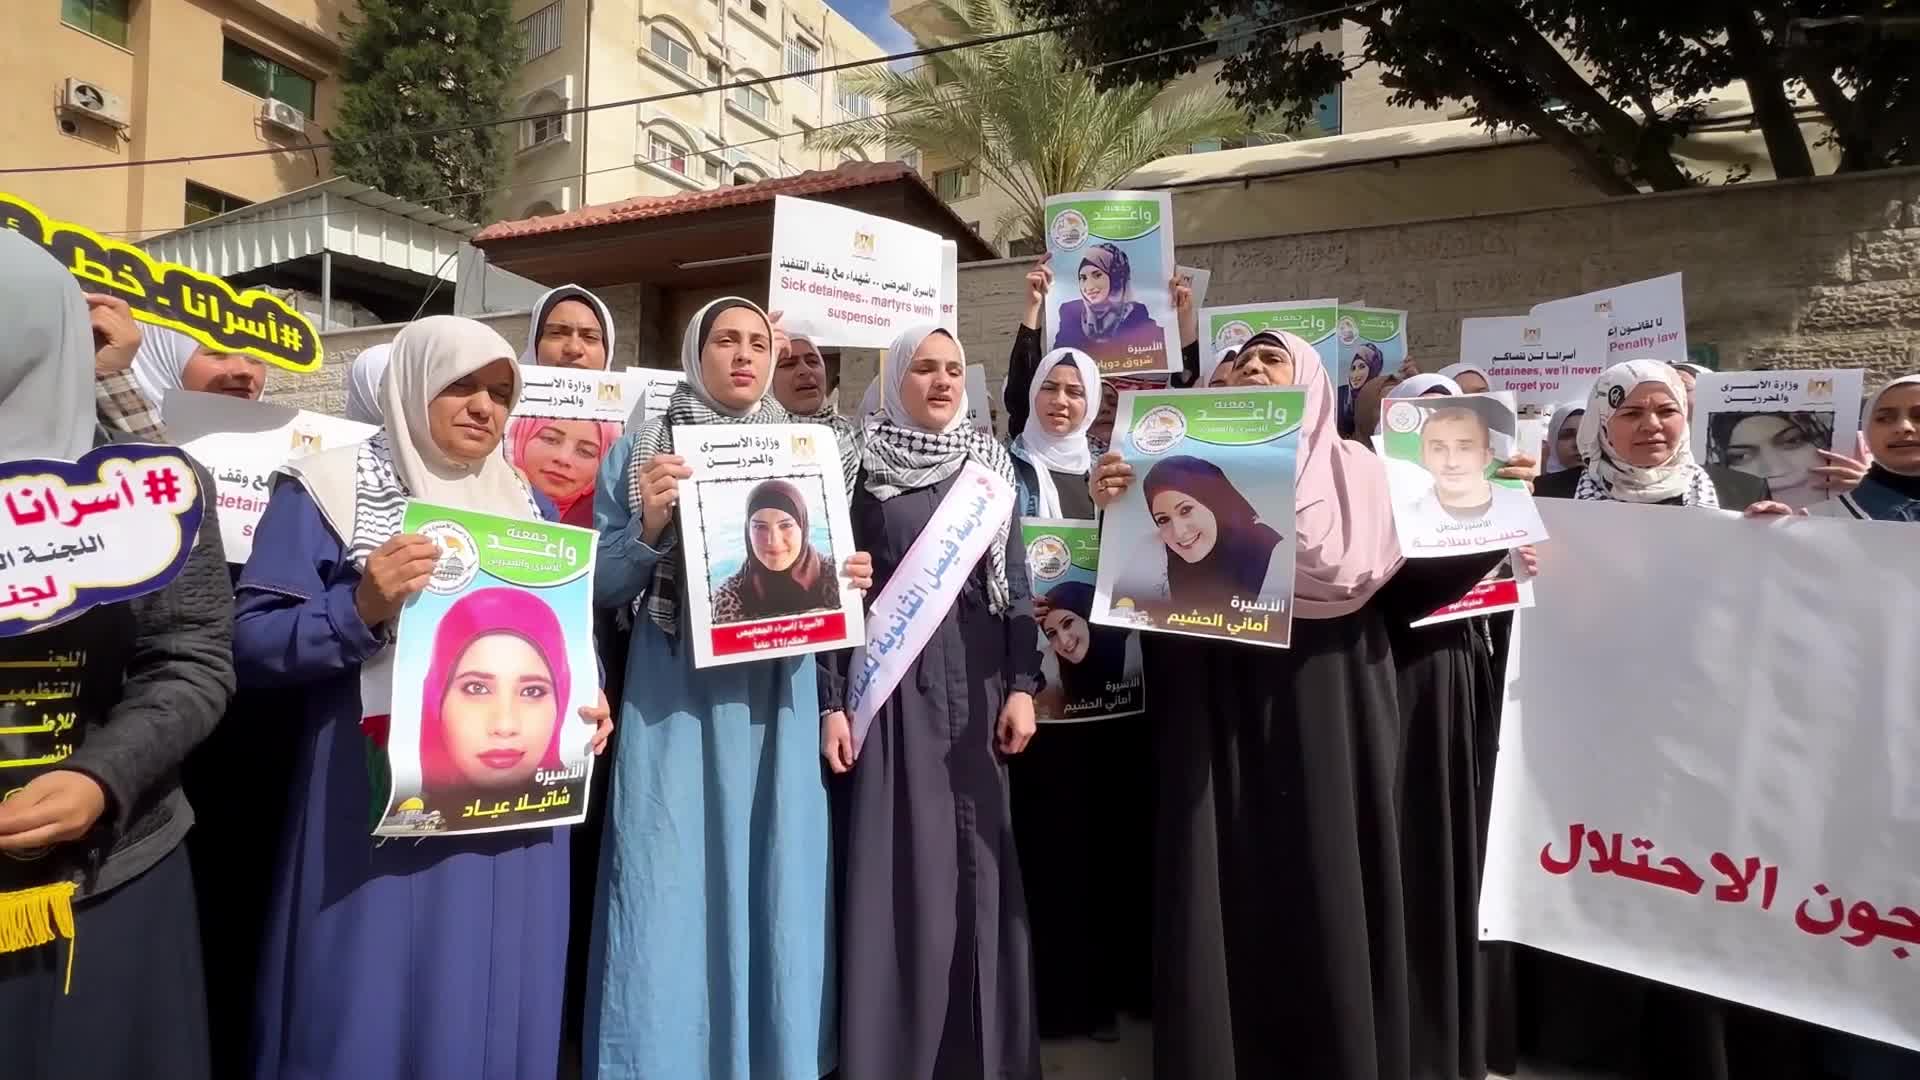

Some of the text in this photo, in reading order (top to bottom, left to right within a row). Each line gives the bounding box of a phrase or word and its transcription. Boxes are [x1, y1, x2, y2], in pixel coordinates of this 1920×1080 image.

[1093, 206, 1152, 224] واعد
[69, 246, 147, 297] خط
[779, 256, 809, 272] التنفيذ
[811, 261, 830, 279] وقف
[831, 268, 844, 281] مع
[846, 270, 871, 286] شهداء
[781, 277, 806, 291] Sick
[871, 295, 912, 312] martyrs
[914, 303, 934, 317] with
[827, 306, 891, 328] suspension
[1620, 319, 1654, 336] لقانون
[1609, 331, 1680, 352] Penalty law
[1122, 354, 1153, 368] شروق
[1528, 351, 1544, 362] لن
[1571, 366, 1602, 375] never
[568, 379, 592, 393] وزارة
[1505, 381, 1560, 392] forget you
[1773, 379, 1799, 391] وزارة
[1724, 393, 1789, 405] والمحررين
[1195, 399, 1288, 425] واعد
[755, 435, 780, 451] وزارة
[706, 453, 774, 468] والمحررين
[218, 467, 248, 488] وقف
[946, 496, 987, 541] مدرسة
[506, 523, 549, 542] جمعية
[1474, 529, 1529, 545] حسن
[18, 533, 105, 562] اللجنة
[486, 533, 577, 567] واعد
[923, 539, 961, 590] فيصل
[0, 575, 57, 608] لجن
[869, 583, 929, 656] الثانوية
[1166, 609, 1270, 635] أماني الحشيم
[0, 649, 87, 672] اللجن
[0, 681, 81, 706] التنظيمي
[1063, 690, 1131, 715] أماني الحشيم
[462, 786, 571, 818] شاتيلا عياد
[1794, 883, 1920, 960] جون
